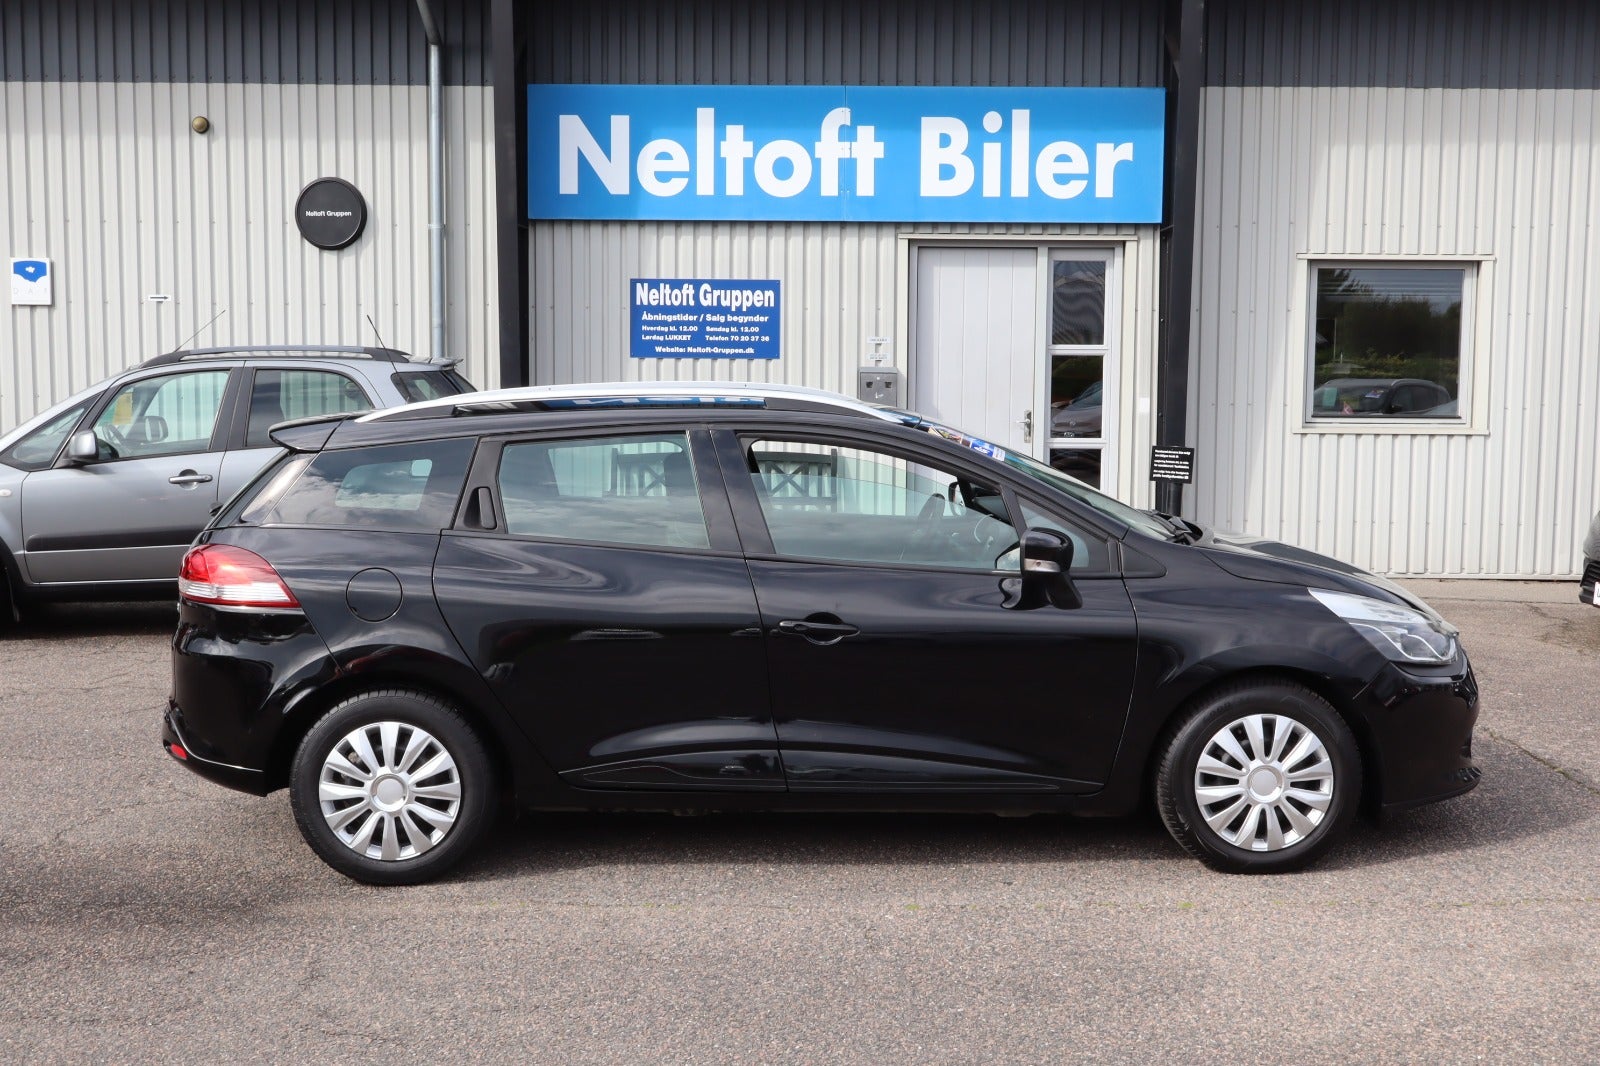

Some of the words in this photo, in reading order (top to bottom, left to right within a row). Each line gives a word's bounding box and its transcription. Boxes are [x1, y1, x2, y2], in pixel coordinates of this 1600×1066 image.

[559, 107, 884, 197] Neltoft
[920, 109, 1133, 199] Biler
[636, 283, 695, 306] Neltoft
[699, 283, 775, 312] Gruppen
[641, 311, 698, 322] Åbningstider
[705, 314, 726, 322] Salg
[727, 314, 769, 323] begynder
[687, 346, 755, 355] Neltoft-Gruppen.dk
